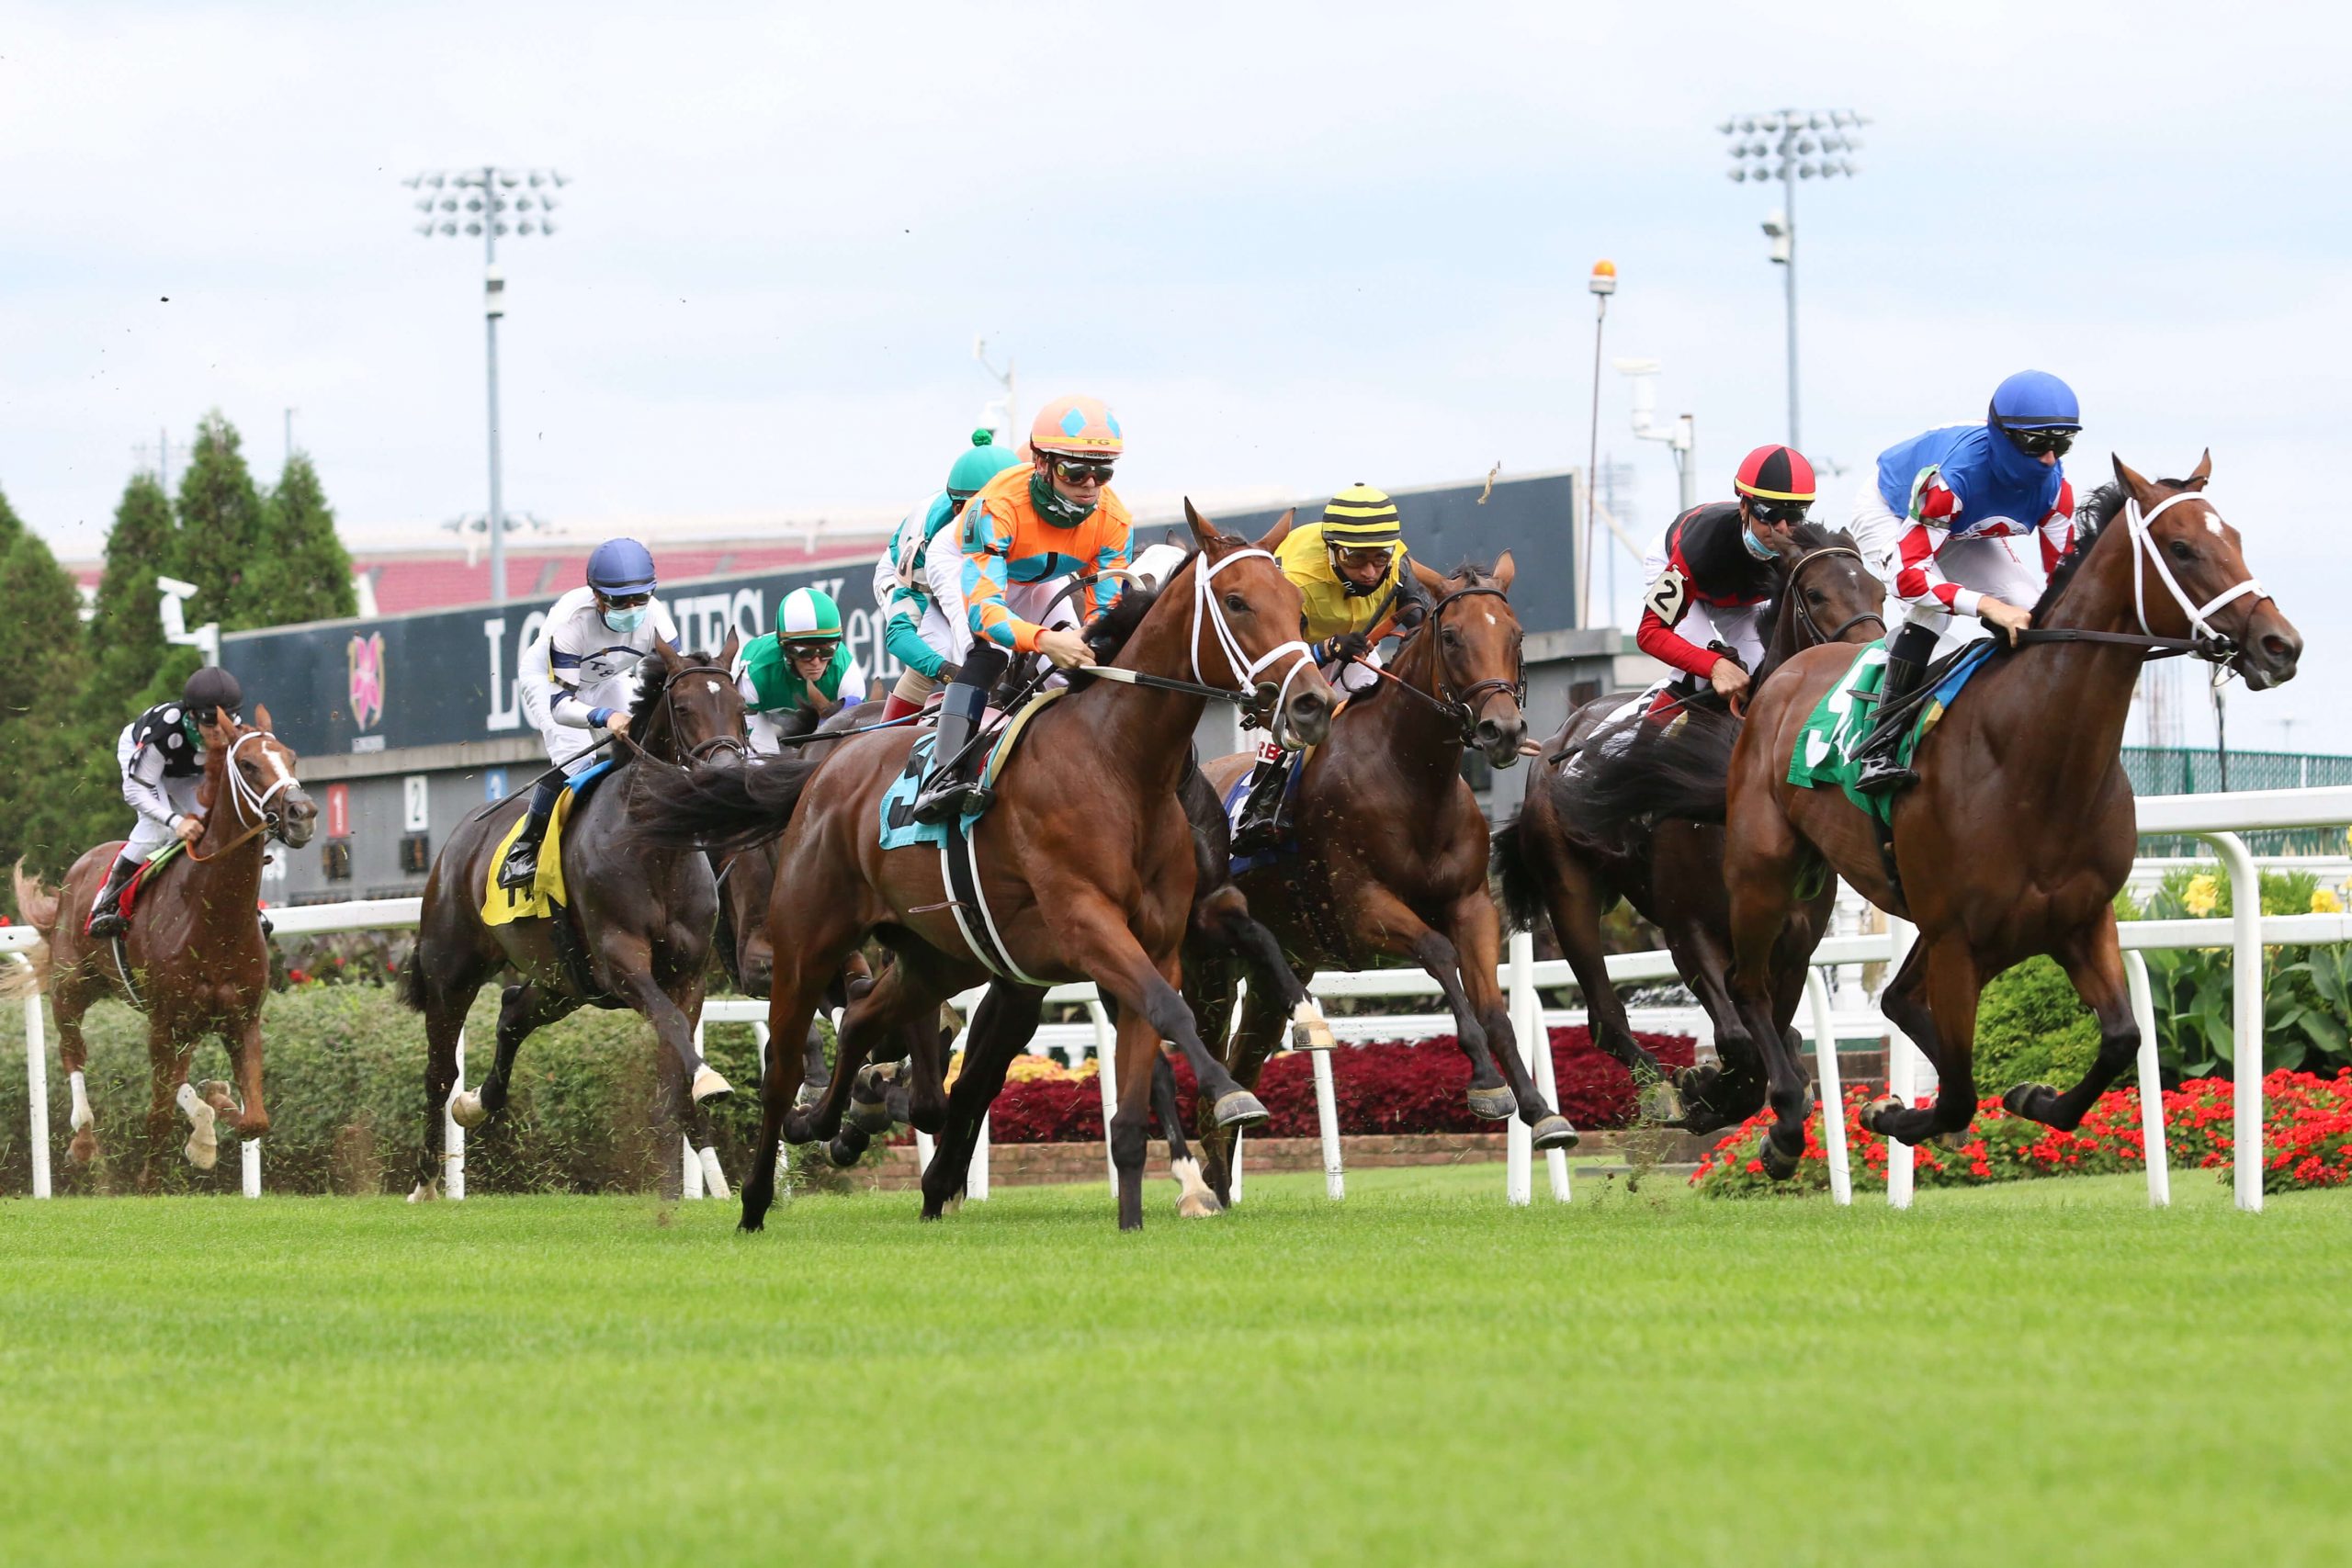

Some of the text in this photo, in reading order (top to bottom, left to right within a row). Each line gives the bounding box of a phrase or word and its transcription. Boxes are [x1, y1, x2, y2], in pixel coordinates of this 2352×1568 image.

[1654, 580, 1678, 613] 2
[484, 588, 764, 731] LOES
[333, 790, 344, 832] 1
[412, 781, 422, 821] 2
